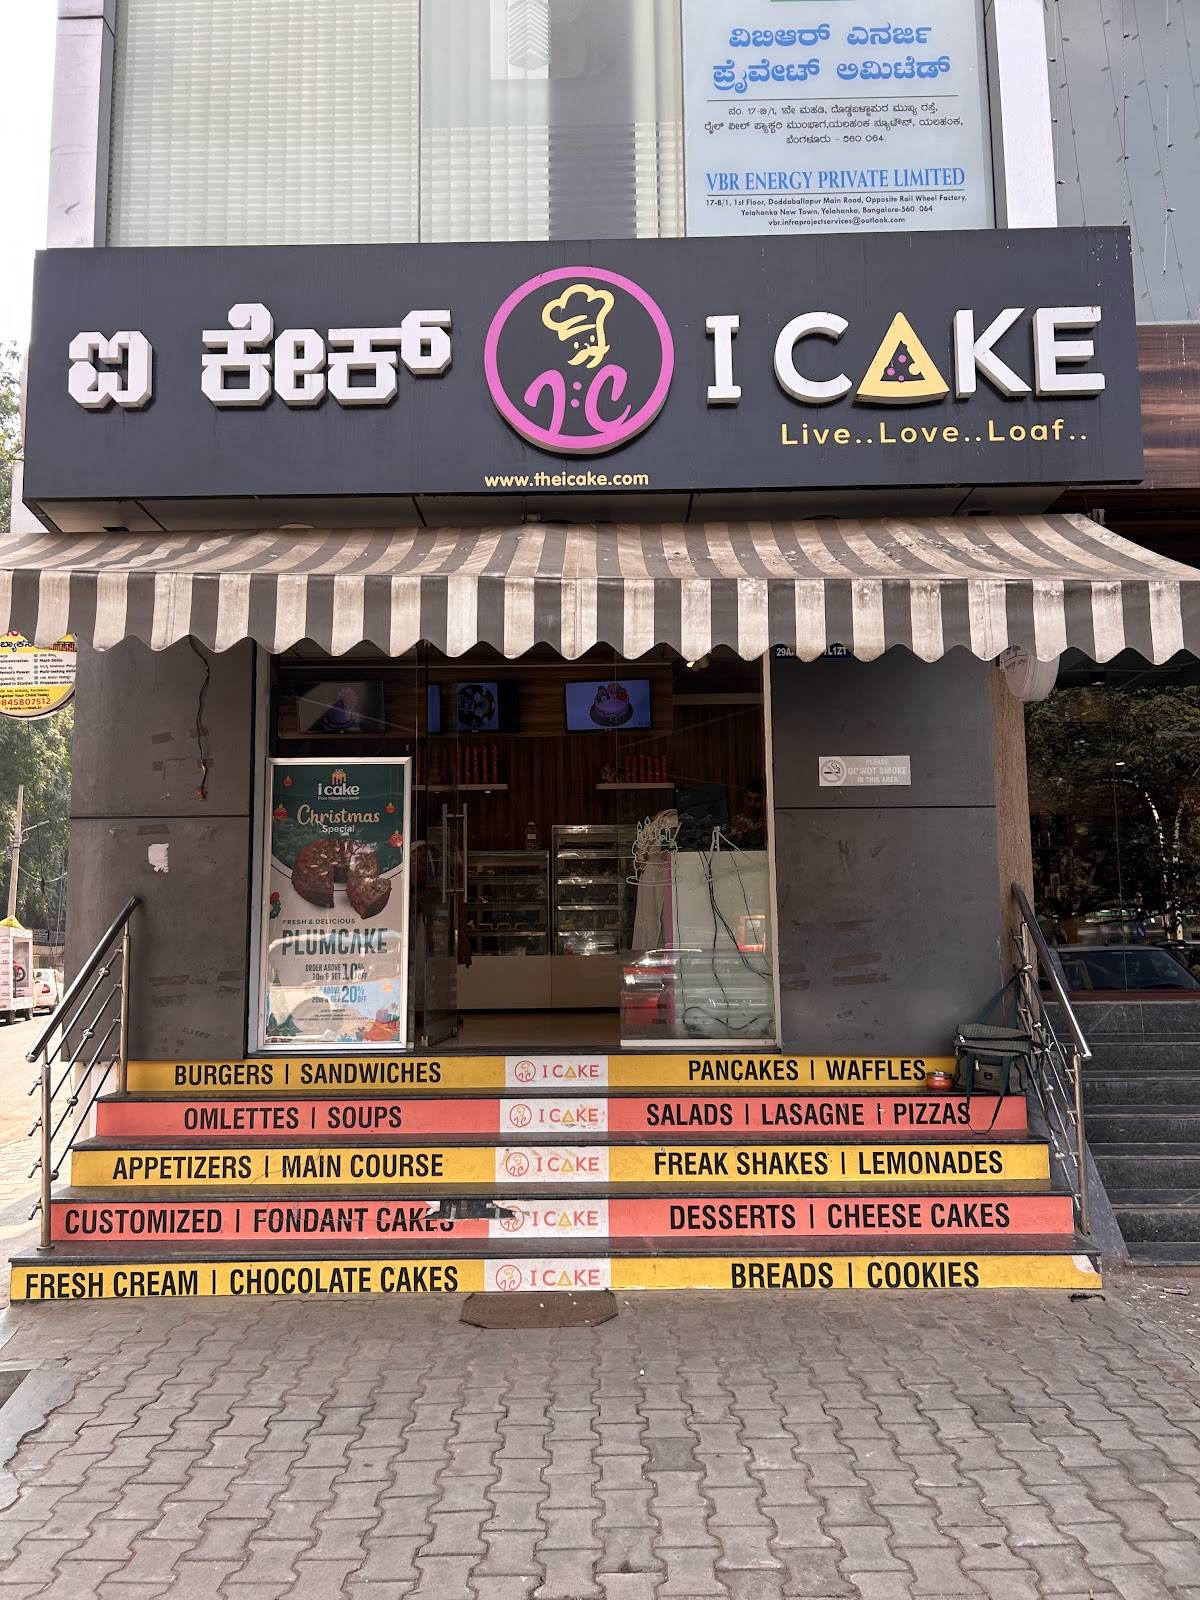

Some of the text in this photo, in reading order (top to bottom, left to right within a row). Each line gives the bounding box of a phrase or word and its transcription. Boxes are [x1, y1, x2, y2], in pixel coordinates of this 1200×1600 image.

[729, 23, 830, 47] ವಿಬಿಆರ್
[713, 55, 951, 93] ಪ್ರೈವೇಟ್ ಲಿಮಿಟೆಡ್
[706, 167, 965, 192] VBR ENERGY PRIVATE LIMITED
[823, 197, 841, 205] Main
[865, 195, 898, 205] Opposite
[915, 194, 937, 202] Wheel
[780, 208, 797, 216] New
[68, 303, 451, 409] ಐ ಕೇಕ್
[705, 305, 1106, 405] I CAKE
[484, 471, 650, 488] www.theicake.com
[297, 804, 380, 826] Christmas
[322, 825, 355, 834] Special
[281, 928, 388, 956] PLUMCAKE
[175, 1064, 273, 1086] BURGERS
[301, 1062, 441, 1084] SANDWICHES
[553, 1064, 599, 1078] CAKE
[689, 1060, 798, 1081] PANCAKES
[827, 1059, 926, 1080] WAFFLES
[185, 1107, 299, 1130] OMLETTES
[328, 1106, 402, 1129] SOUPS
[549, 1108, 599, 1123] CAKE
[647, 1104, 733, 1126] SALADS
[762, 1103, 864, 1126] LASAGNE
[894, 1102, 970, 1125] PIZZAS
[112, 1156, 251, 1180] APPETIZERS
[282, 1155, 341, 1178] MAIN
[351, 1154, 443, 1178] COURSE
[547, 1156, 600, 1172] CAKE
[655, 1153, 728, 1175] FREAK
[737, 1152, 827, 1175] SHAKES
[859, 1151, 1003, 1174] LEMONADES
[65, 1210, 222, 1235] CUSTOMIZED
[254, 1208, 369, 1233] FONDANT
[543, 1210, 599, 1226] CAKE
[671, 1204, 795, 1229] DESSERTS
[828, 1204, 922, 1229] CHEESE
[931, 1203, 1010, 1228] CAKES
[26, 1274, 103, 1299] FRESH
[114, 1271, 198, 1296] CREAM
[229, 1267, 371, 1295] CHOCOLATE
[381, 1266, 458, 1293] CAKES
[543, 1269, 600, 1286] CAKE
[732, 1263, 833, 1288] BREADS
[868, 1262, 979, 1289] COOKIES
